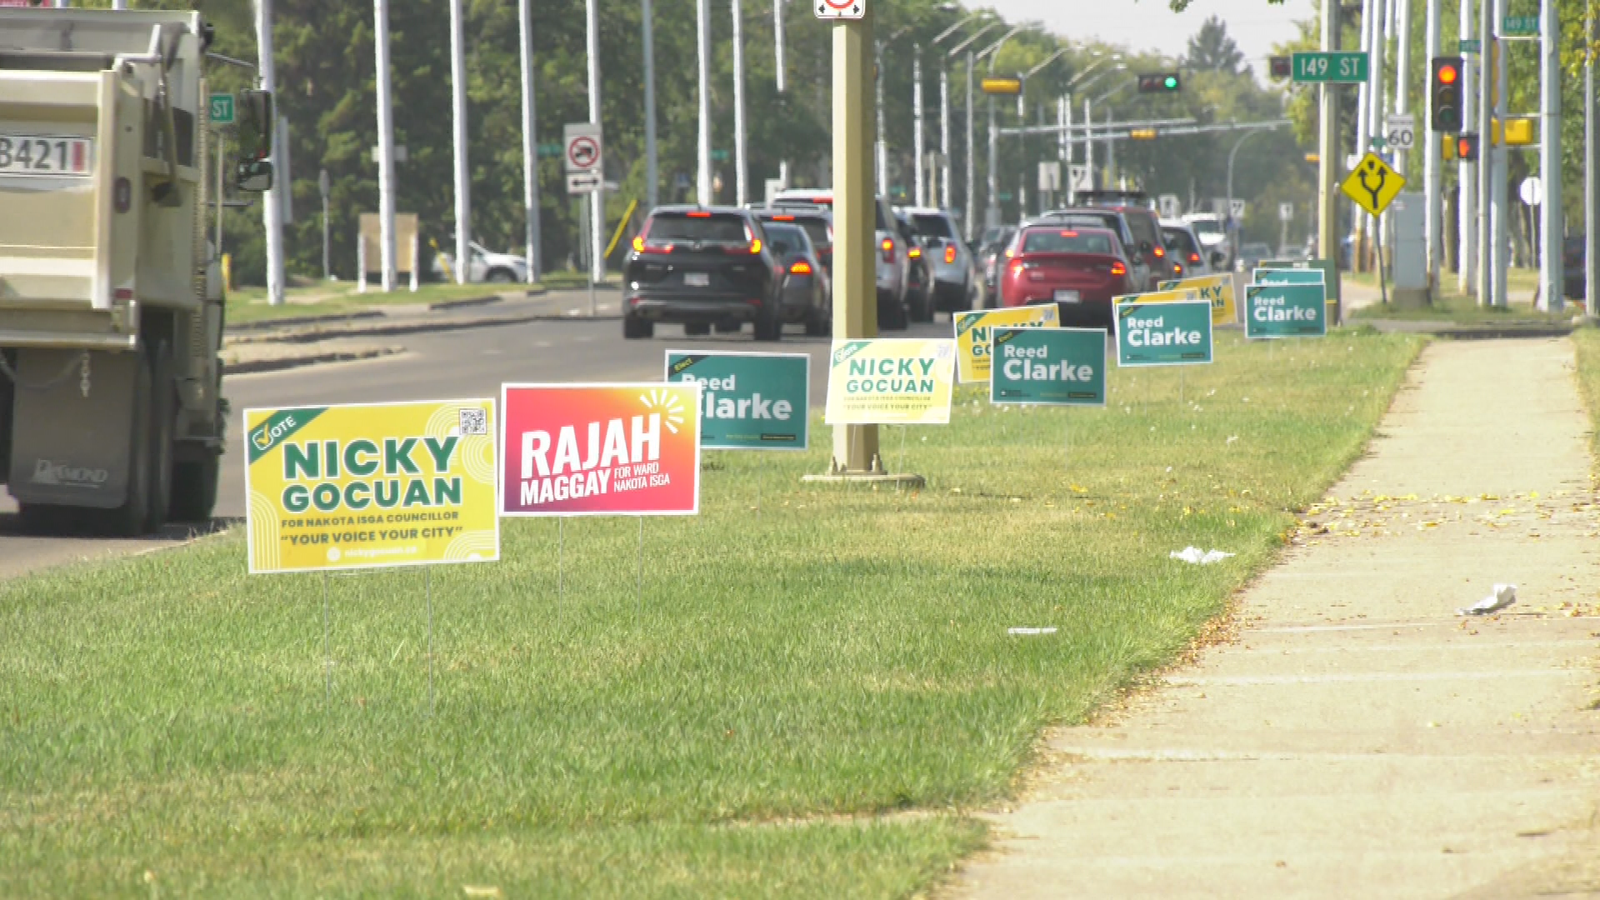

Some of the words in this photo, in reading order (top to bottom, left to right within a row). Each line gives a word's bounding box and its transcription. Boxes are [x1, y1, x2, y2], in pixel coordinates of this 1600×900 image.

[1300, 57, 1329, 76] 149
[1339, 57, 1361, 76] ST
[212, 101, 228, 118] ST
[1388, 129, 1413, 146] 60
[1253, 295, 1285, 306] Reed
[1127, 315, 1163, 329] Reed
[1253, 305, 1317, 322] Clarke
[1127, 327, 1201, 347] Clarke
[1003, 344, 1048, 358] Reed
[849, 358, 935, 376] NICKY
[1002, 359, 1094, 381] Clarke
[846, 379, 934, 393] GOCUAN
[700, 391, 793, 420] larke
[520, 413, 661, 479] RAJAH
[283, 436, 460, 480] NICKY
[613, 466, 632, 479] FOR
[634, 462, 660, 476] WARD
[520, 468, 612, 506] MAGGAY
[613, 476, 648, 493] NAKOTA
[649, 473, 671, 488] ISGA
[282, 478, 462, 513] GOCUAN
[281, 519, 304, 528] FOR
[306, 516, 354, 527] NAKOTA
[357, 515, 384, 525] ISGA
[386, 511, 459, 523] COUNCILLOR
[332, 530, 376, 543] VOICE
[379, 528, 418, 540] YOUR
